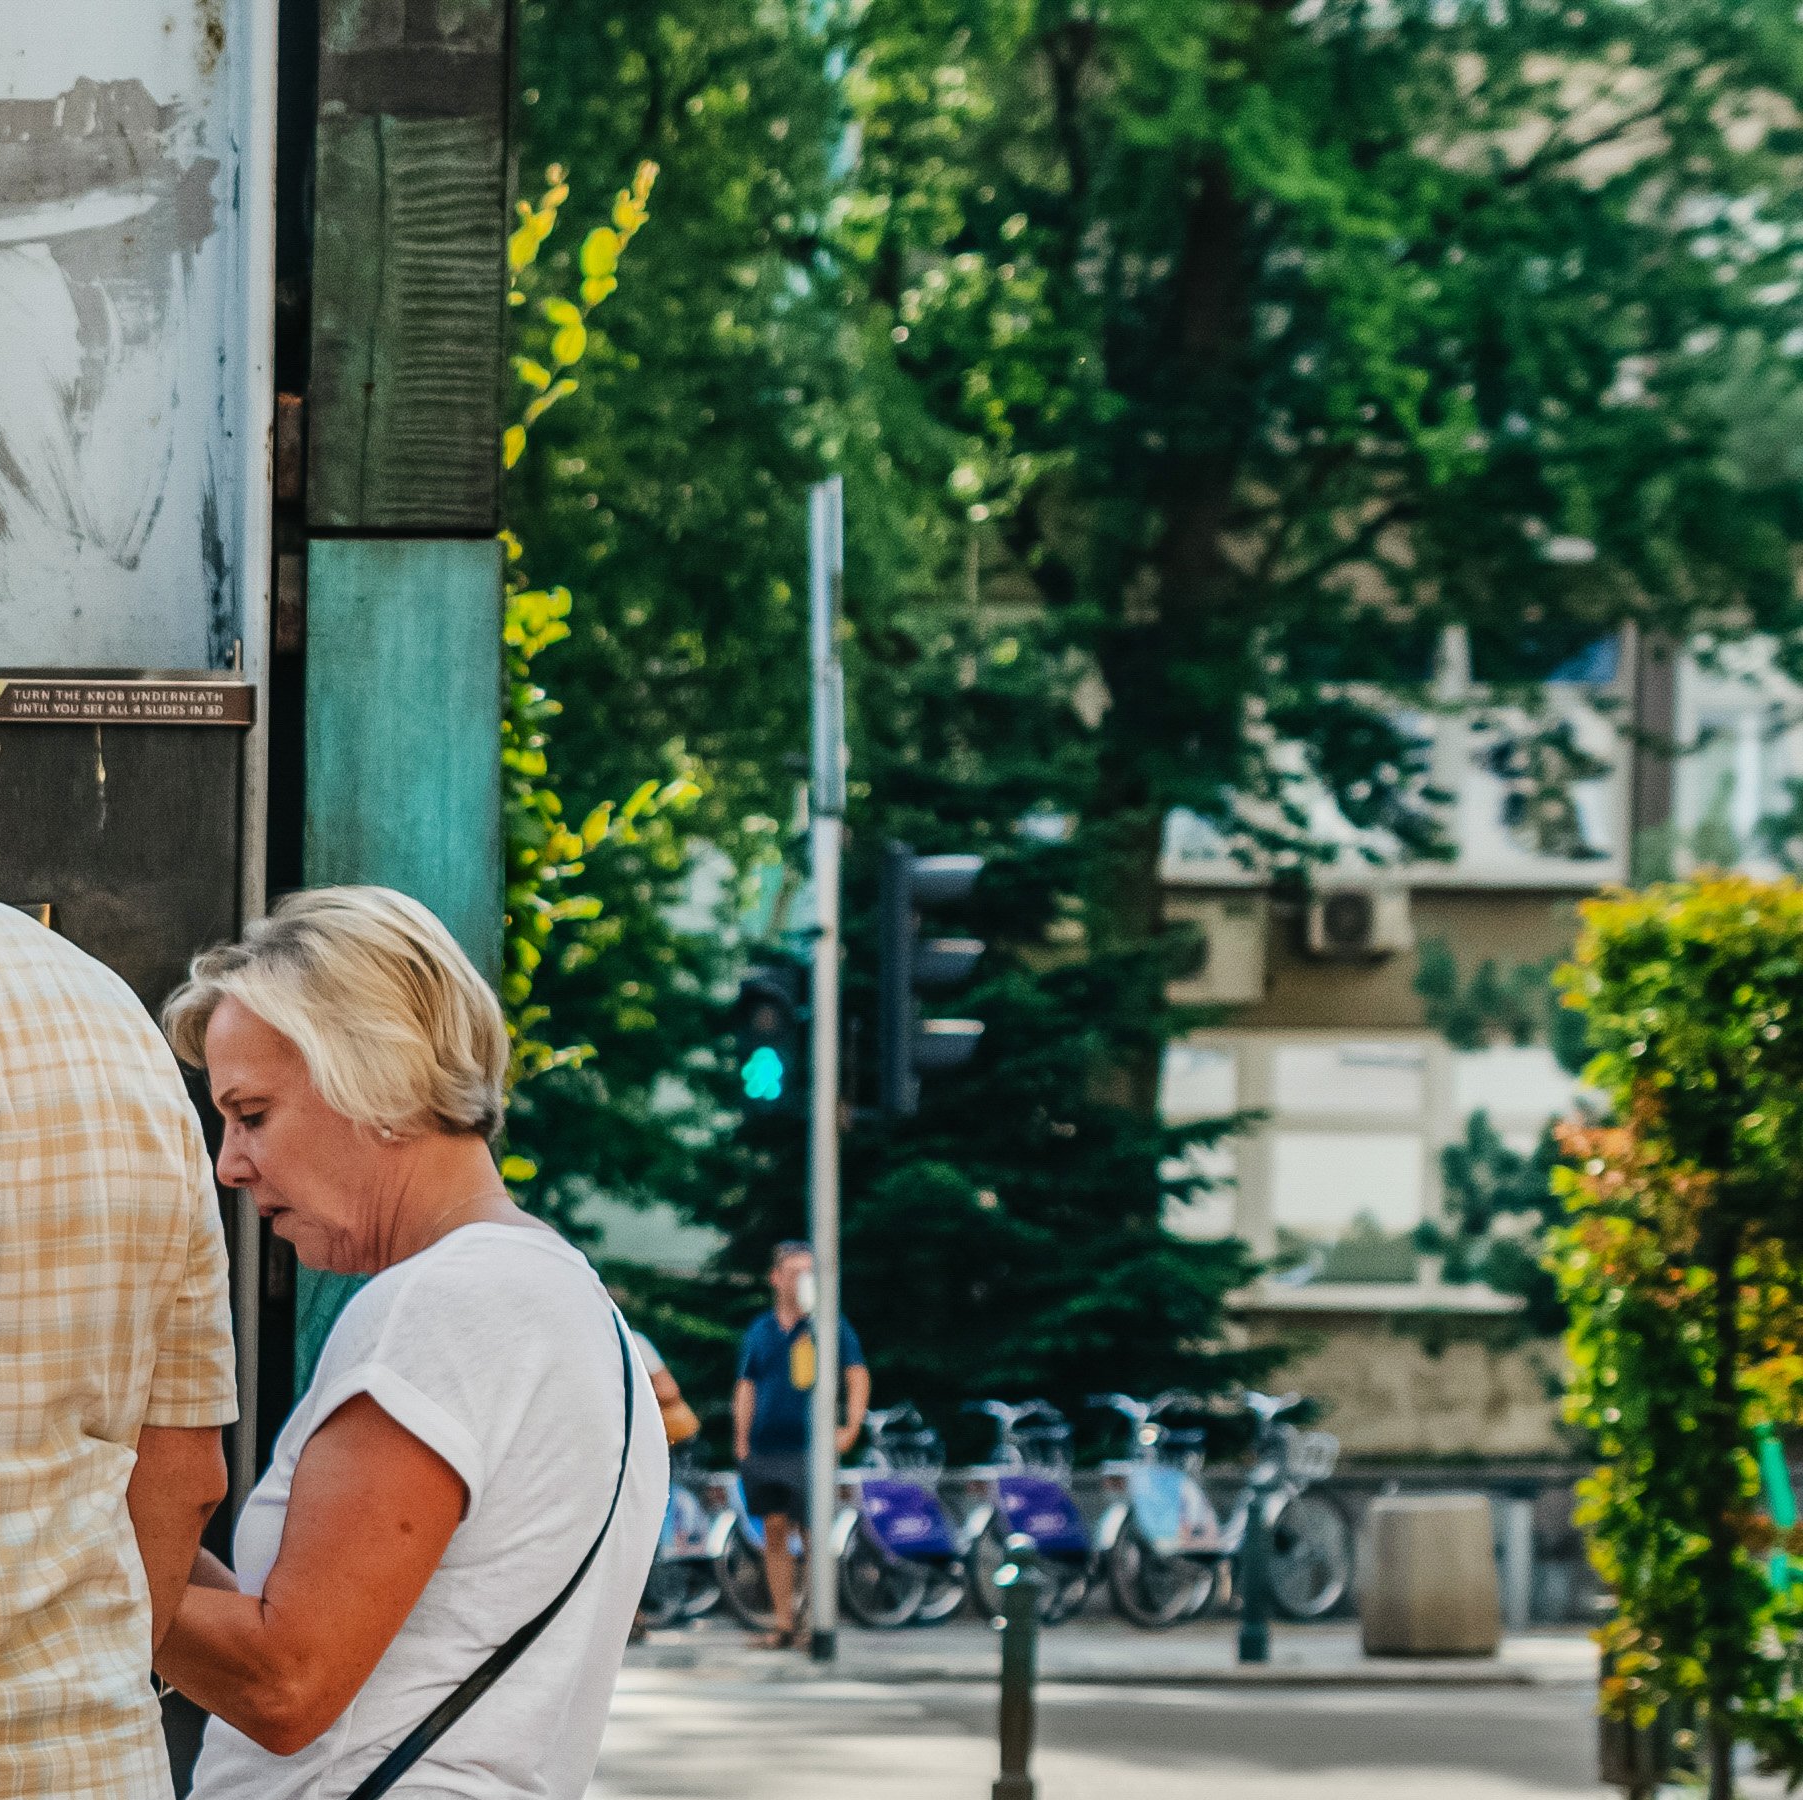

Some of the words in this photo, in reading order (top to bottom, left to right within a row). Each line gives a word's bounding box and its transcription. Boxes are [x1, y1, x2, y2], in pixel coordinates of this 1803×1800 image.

[13, 690, 51, 701] TURN
[55, 690, 81, 701] THE
[87, 690, 125, 701] KNOB
[131, 691, 224, 702] UNDERNEATH
[13, 703, 49, 714] UNTIL
[53, 703, 79, 714] YOU
[83, 704, 103, 715] SEE
[108, 704, 129, 715] ALL
[133, 704, 141, 714] 4
[145, 704, 186, 716] SLIDES
[189, 705, 204, 716] IN
[207, 705, 224, 716] 3D
